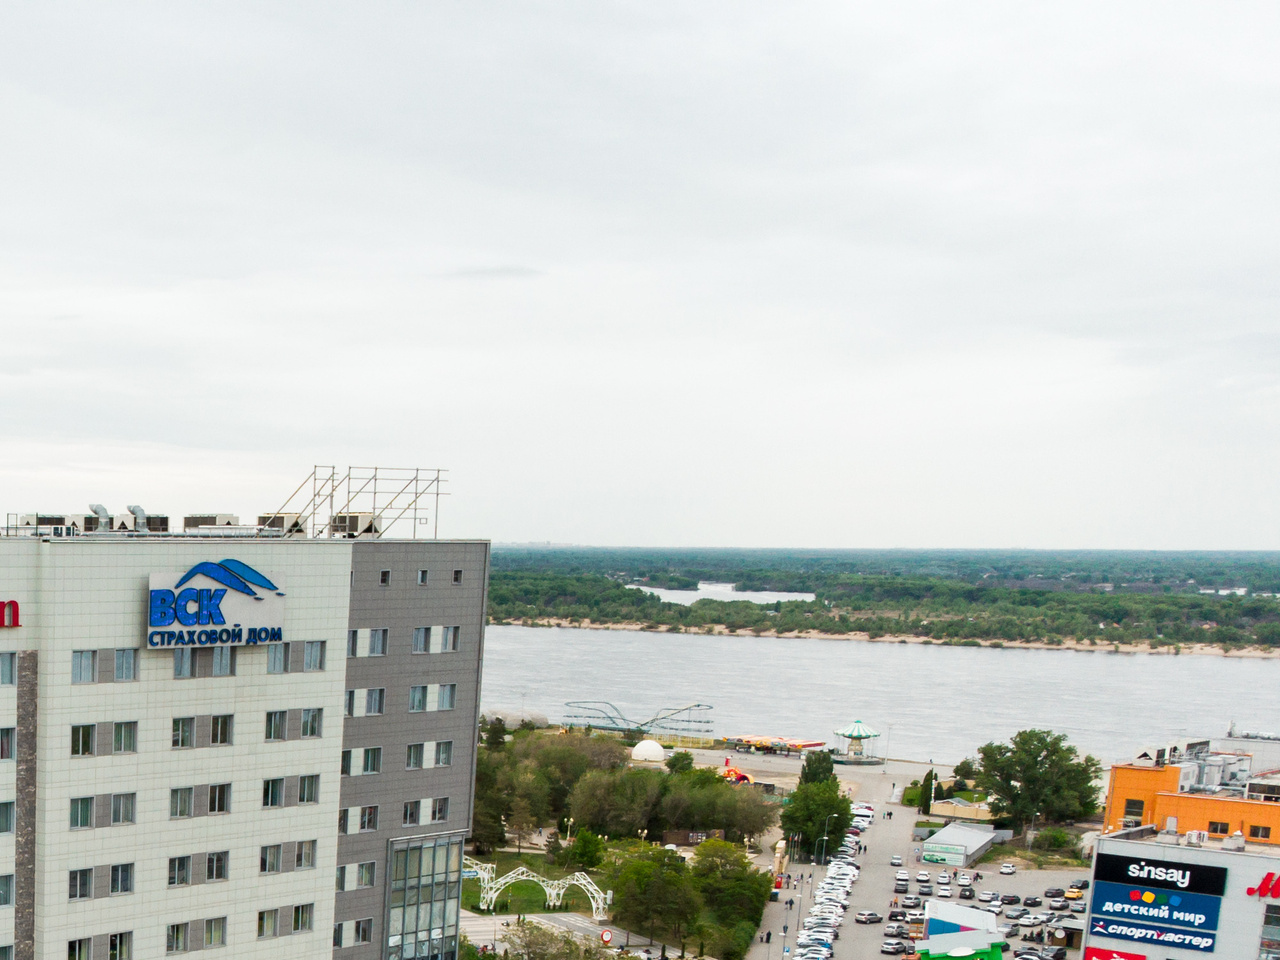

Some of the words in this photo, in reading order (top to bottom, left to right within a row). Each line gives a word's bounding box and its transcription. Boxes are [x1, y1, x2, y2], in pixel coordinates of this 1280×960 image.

[149, 588, 228, 627] ВСК
[148, 623, 243, 647] СТРАХОВОЙ
[245, 627, 283, 645] ДОМ
[1128, 861, 1191, 888] sinsay
[1102, 901, 1169, 919] детский
[1172, 910, 1206, 926] мир
[1107, 924, 1213, 948] спортмастер
